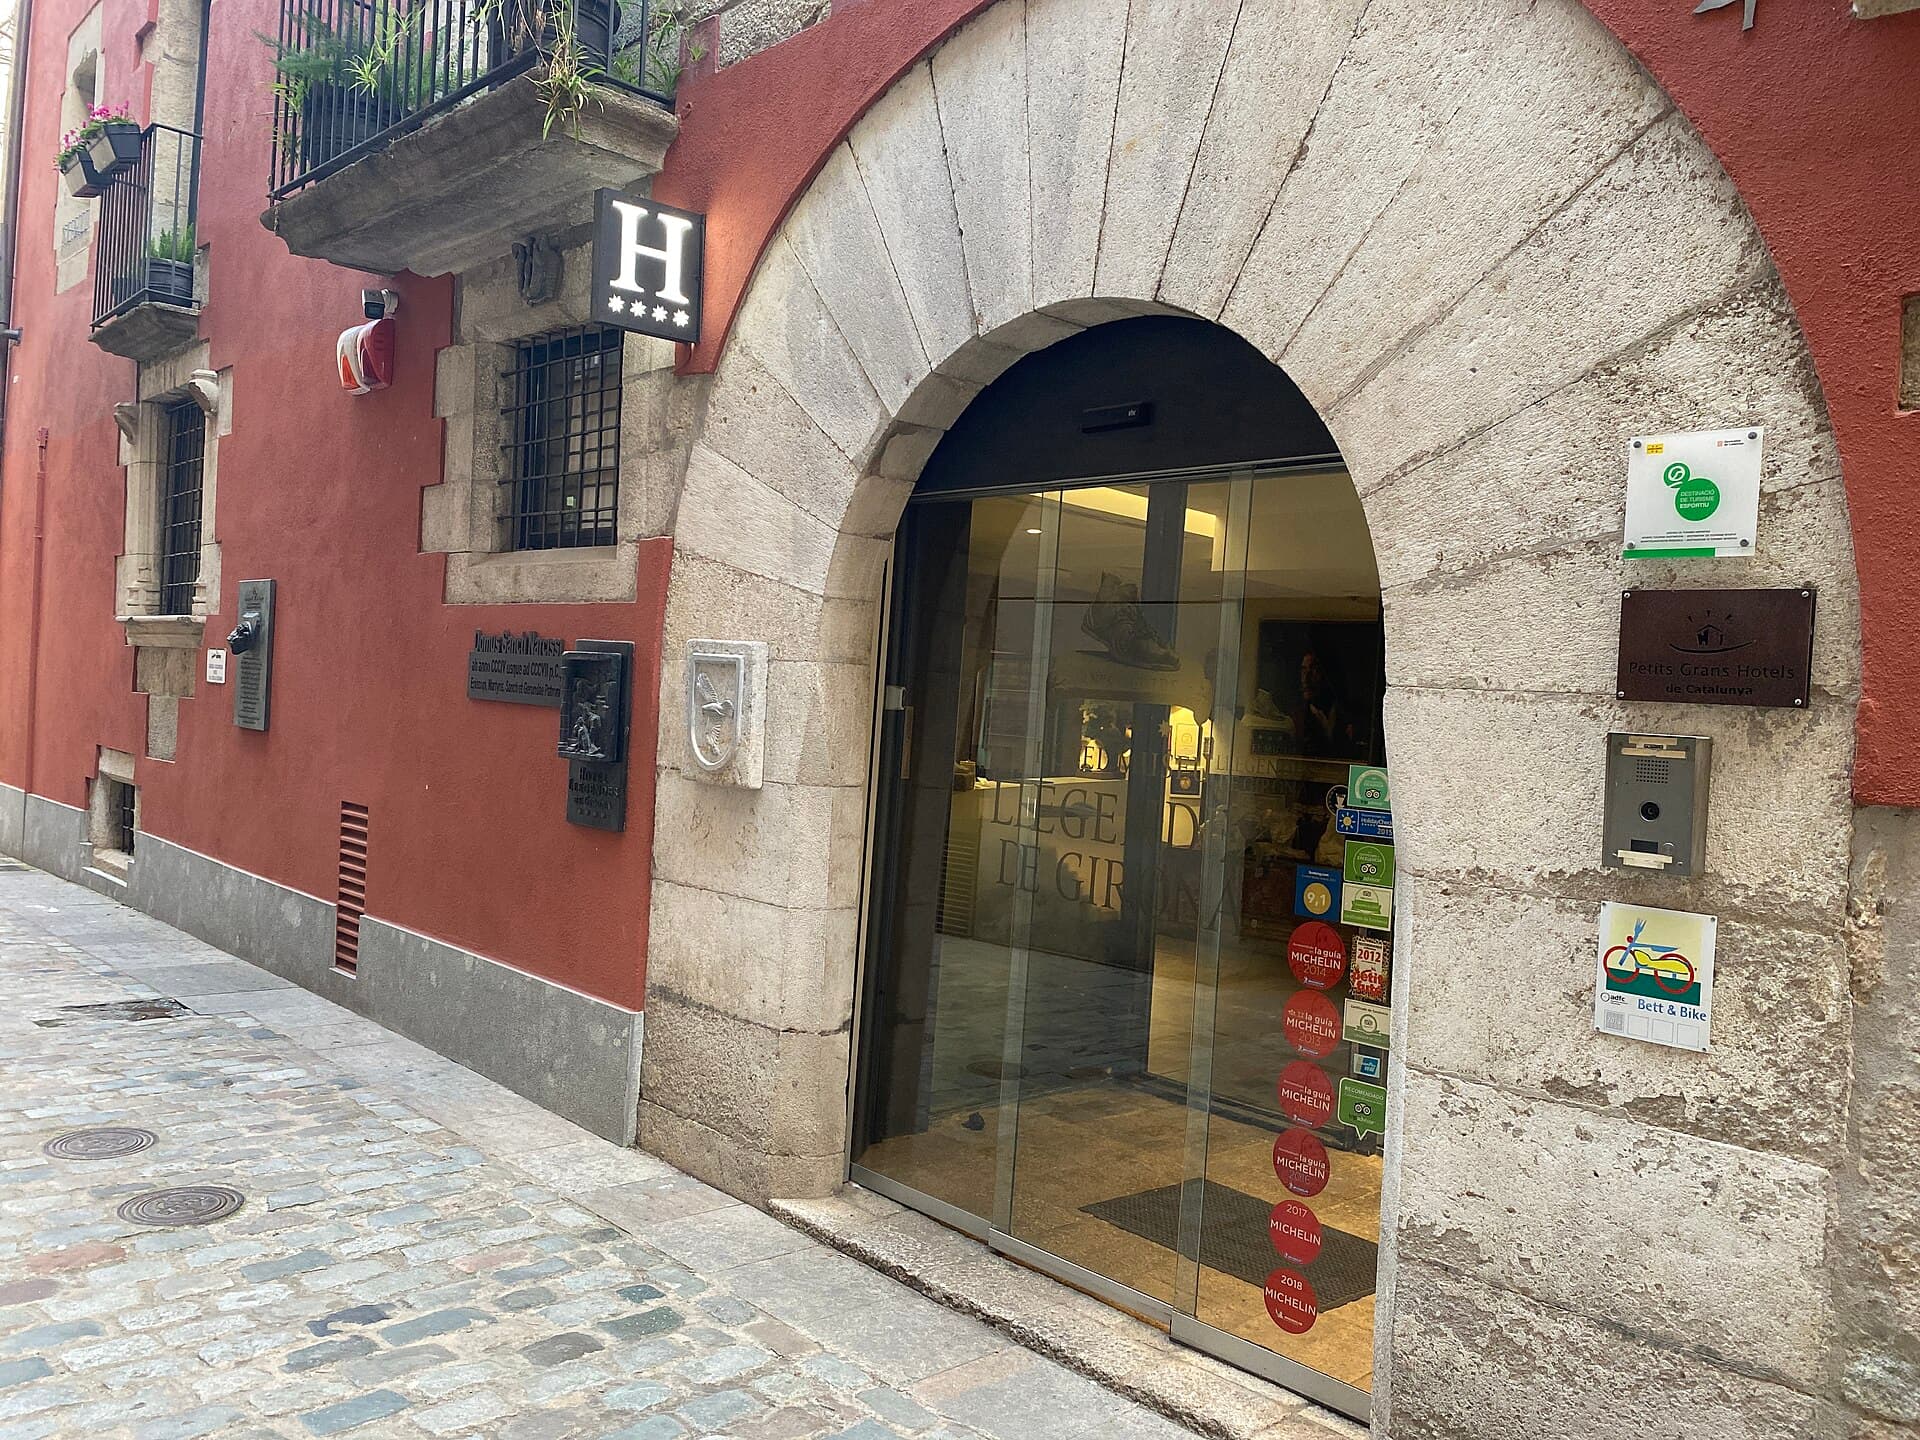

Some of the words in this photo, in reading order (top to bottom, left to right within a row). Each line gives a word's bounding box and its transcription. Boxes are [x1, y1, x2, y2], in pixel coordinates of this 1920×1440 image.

[609, 200, 693, 305] H
[1680, 489, 1715, 497] DESTINACIÓ
[1629, 662, 1673, 676] Petits
[1680, 663, 1729, 677] Grans
[1737, 665, 1794, 680] Hotels
[1666, 684, 1682, 693] de
[1686, 685, 1753, 696] Catalunya
[1377, 828, 1392, 836] 2015
[996, 838, 1041, 893] DE
[1307, 892, 1326, 907] 9,1
[1314, 946, 1322, 955] la
[1357, 948, 1381, 963] 2012
[1291, 951, 1341, 970] MICHELIN
[1303, 964, 1326, 977] 2014
[1610, 994, 1626, 1002] adfc
[1305, 1012, 1312, 1021] la
[1637, 999, 1665, 1014] Bett
[1667, 1004, 1677, 1016] &
[1680, 1006, 1707, 1021] Bike
[1286, 1017, 1336, 1039] MICHELIN
[1298, 1031, 1321, 1047] 2013
[1304, 1085, 1312, 1095] la
[1281, 1088, 1330, 1112] MICHELIN
[1299, 1154, 1307, 1164] la
[1276, 1156, 1325, 1180] MICHELIN
[1286, 1203, 1307, 1218] 2017
[1270, 1219, 1321, 1246] MICHELIN
[1280, 1275, 1303, 1291] 2018
[1265, 1286, 1317, 1316] MICHELIN
